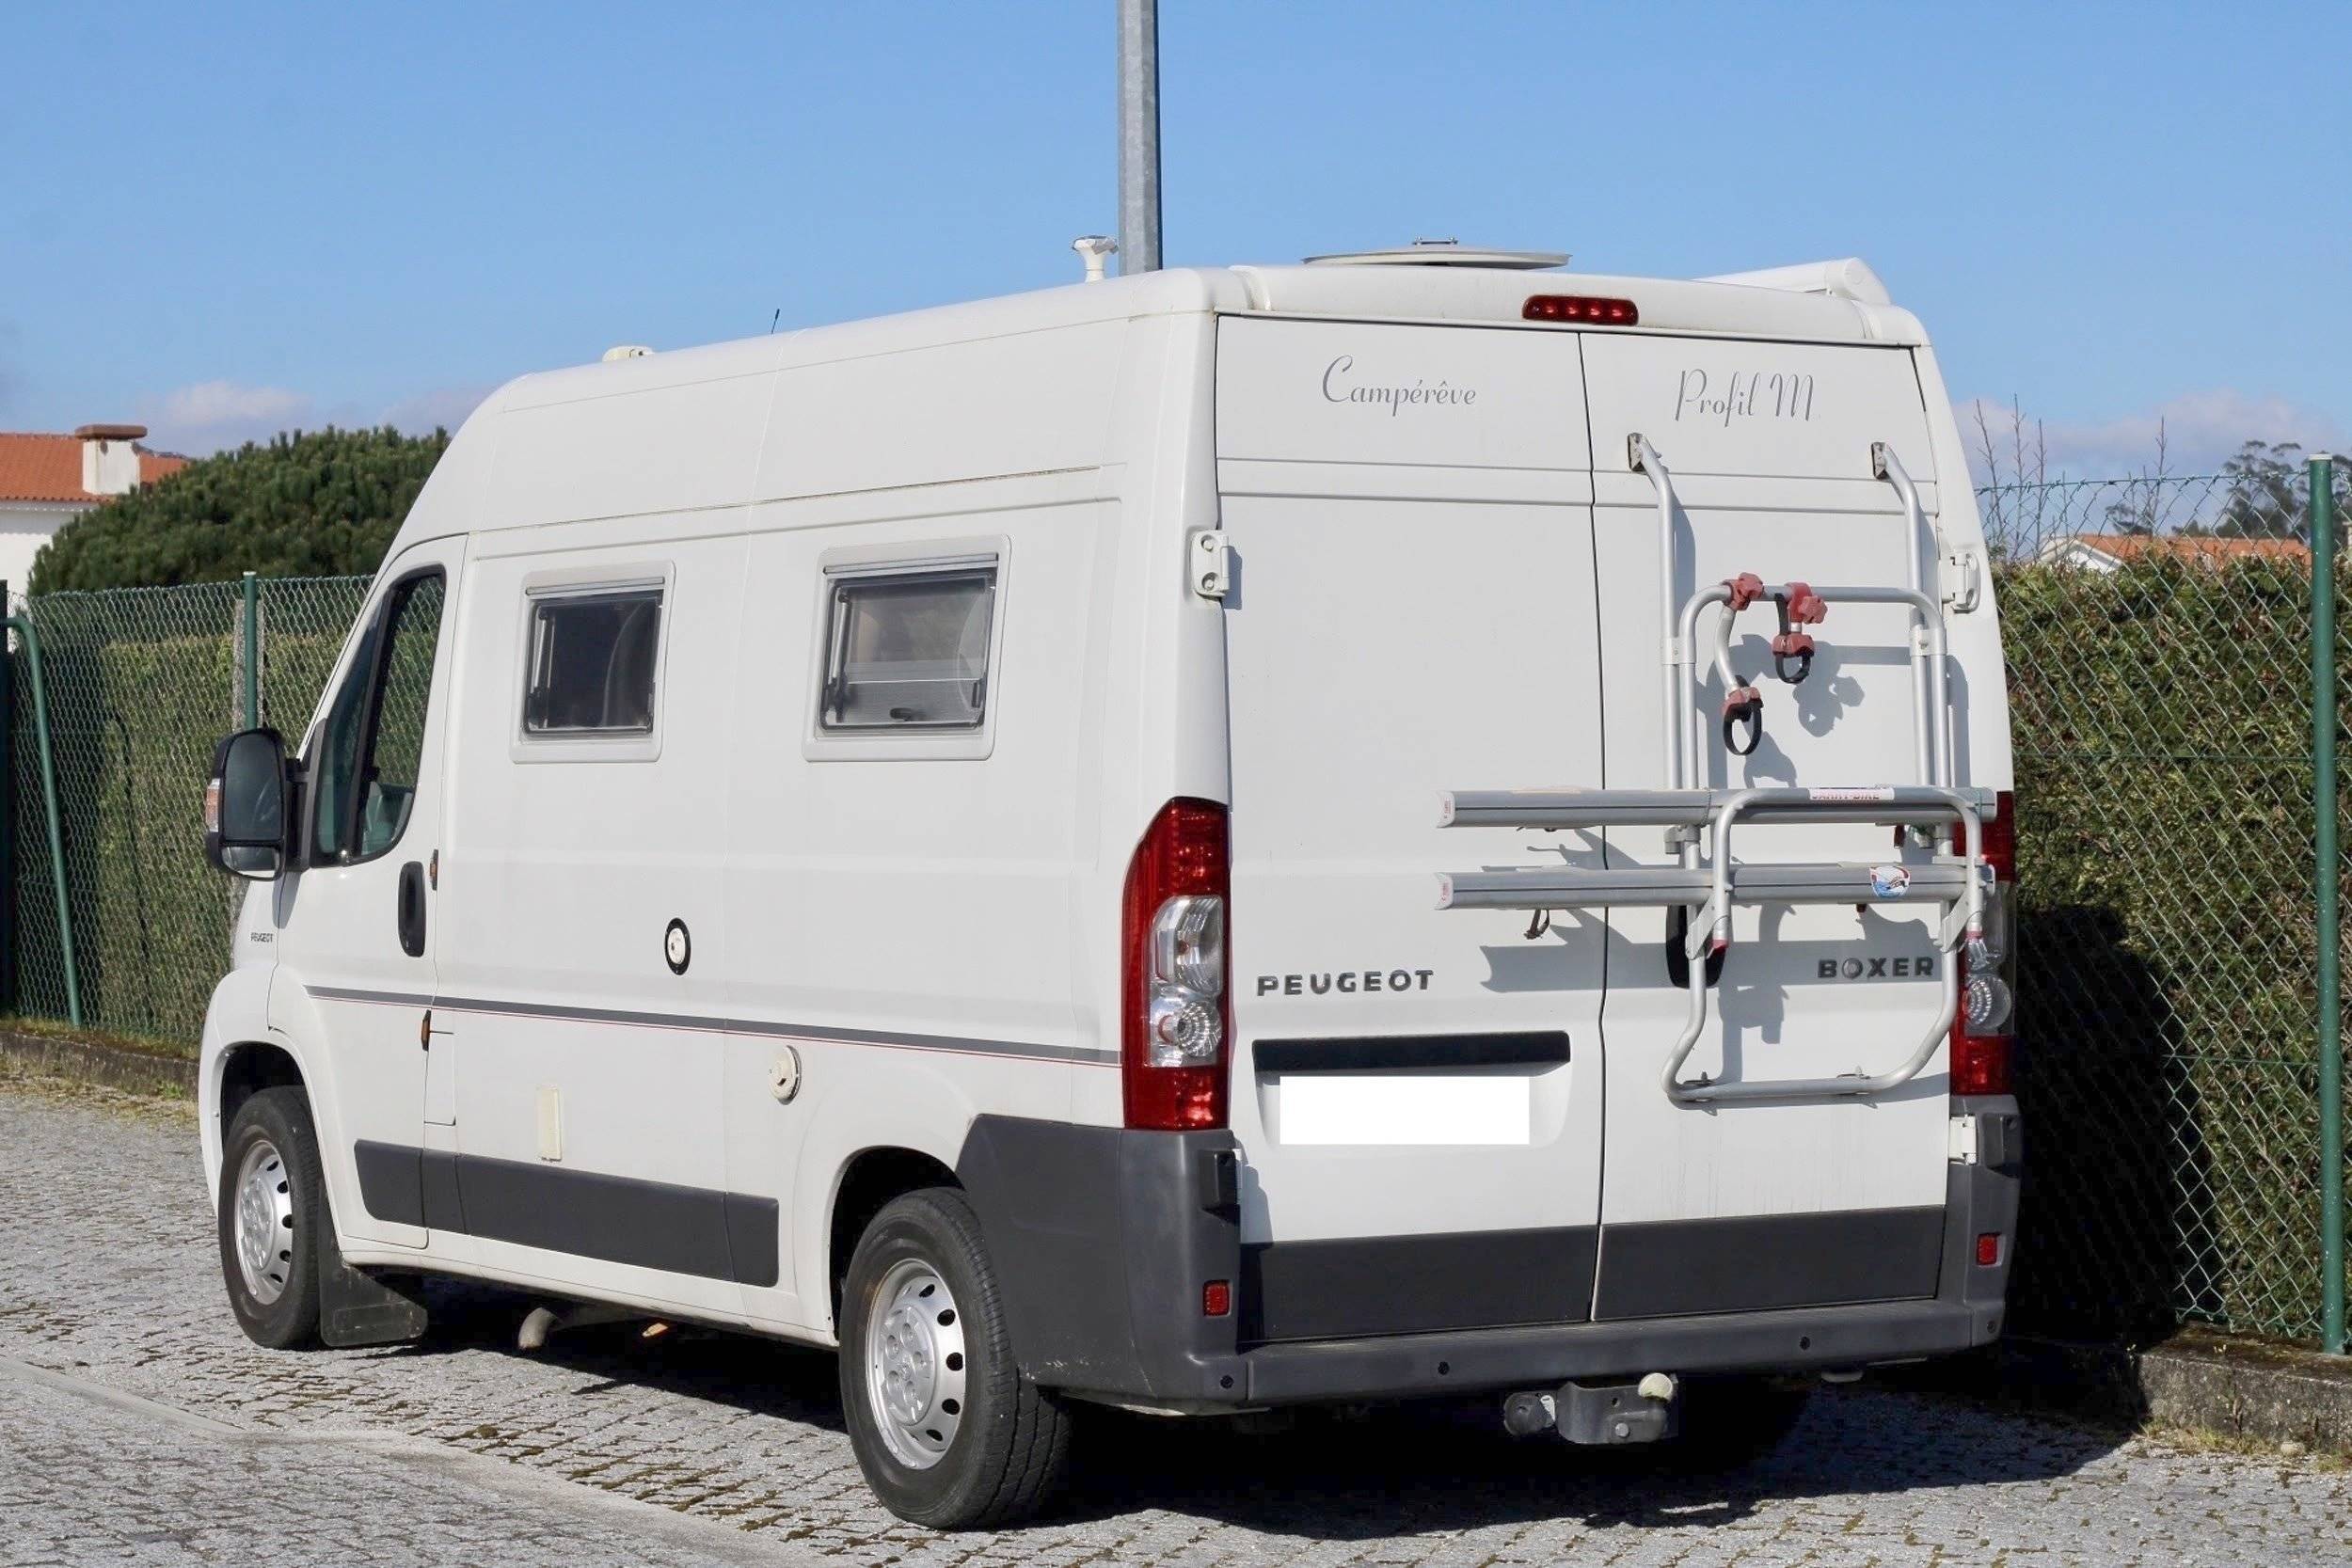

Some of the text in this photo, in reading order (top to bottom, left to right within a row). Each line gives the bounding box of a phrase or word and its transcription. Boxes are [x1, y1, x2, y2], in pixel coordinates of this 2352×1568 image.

[1322, 355, 1476, 417] Campérêve
[1675, 369, 1813, 427] Profil M
[1256, 969, 1434, 997] PEUGEOT
[1818, 957, 1934, 979] BOXER
